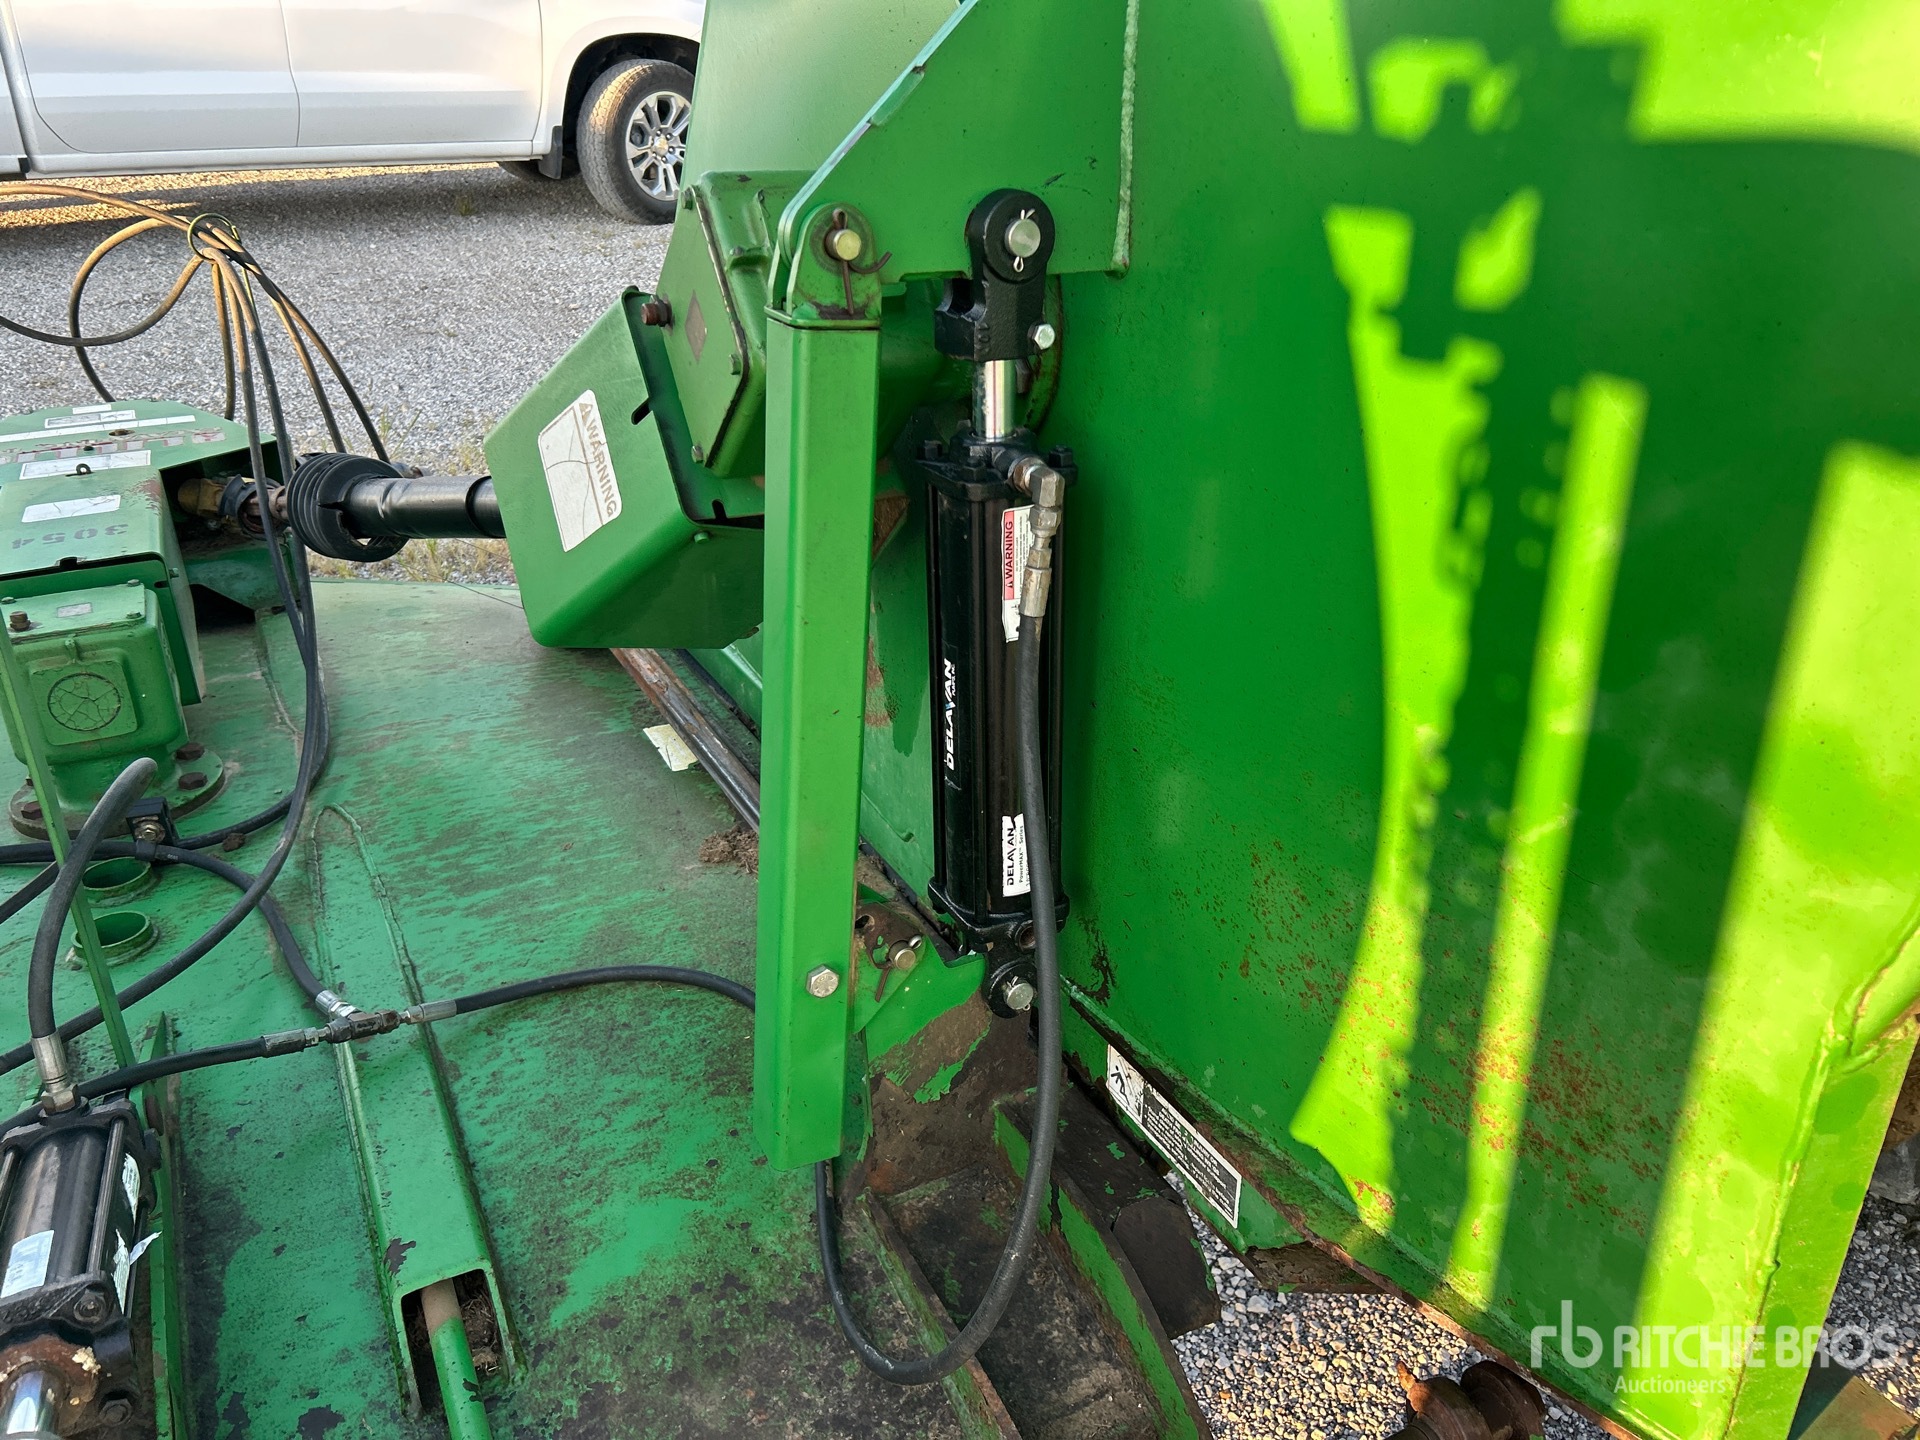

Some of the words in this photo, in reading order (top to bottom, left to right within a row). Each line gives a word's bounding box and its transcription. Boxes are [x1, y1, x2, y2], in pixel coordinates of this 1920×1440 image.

[586, 419, 617, 518] WARNING
[12, 524, 129, 549] 3054
[1005, 521, 1014, 580] WARNING
[943, 658, 956, 771] DELAVAN
[1007, 827, 1016, 886] DELAVAN
